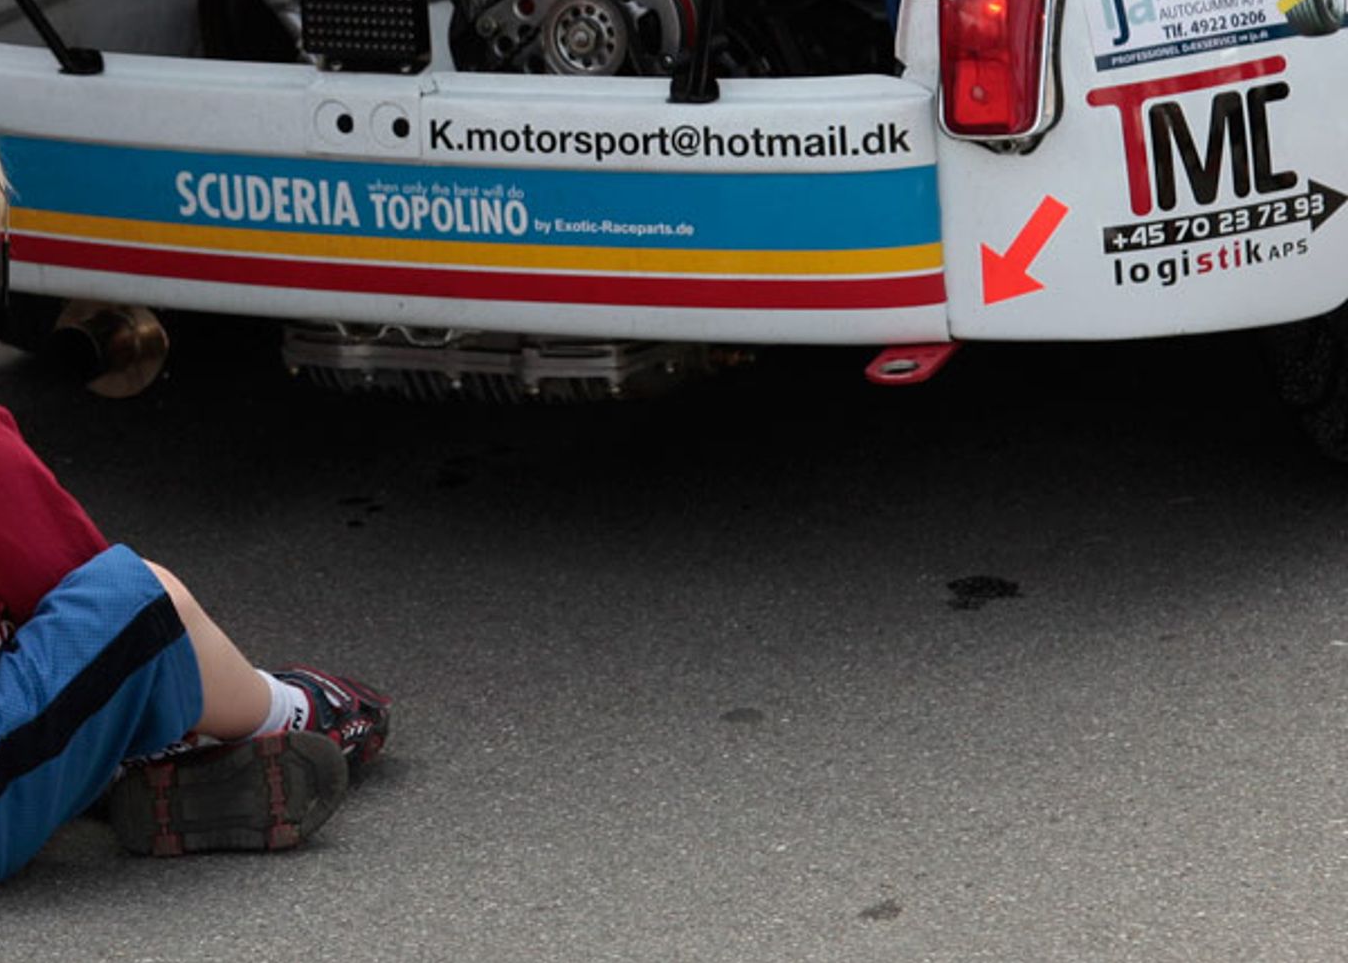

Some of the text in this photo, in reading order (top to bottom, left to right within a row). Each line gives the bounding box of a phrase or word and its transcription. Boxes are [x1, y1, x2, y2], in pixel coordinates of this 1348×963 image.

[1190, 14, 1228, 35] 4922
[1230, 9, 1266, 28] 0206
[429, 118, 910, 162] K.motorsport@hotmail.dk
[1086, 54, 1298, 216] TMC
[175, 170, 359, 228] SCUDERIA
[369, 193, 694, 236] TOPOLINO by Exotic-Raceparts.de
[1112, 193, 1325, 250] +45 70 23 72 93
[1114, 239, 1308, 287] logistik APS
